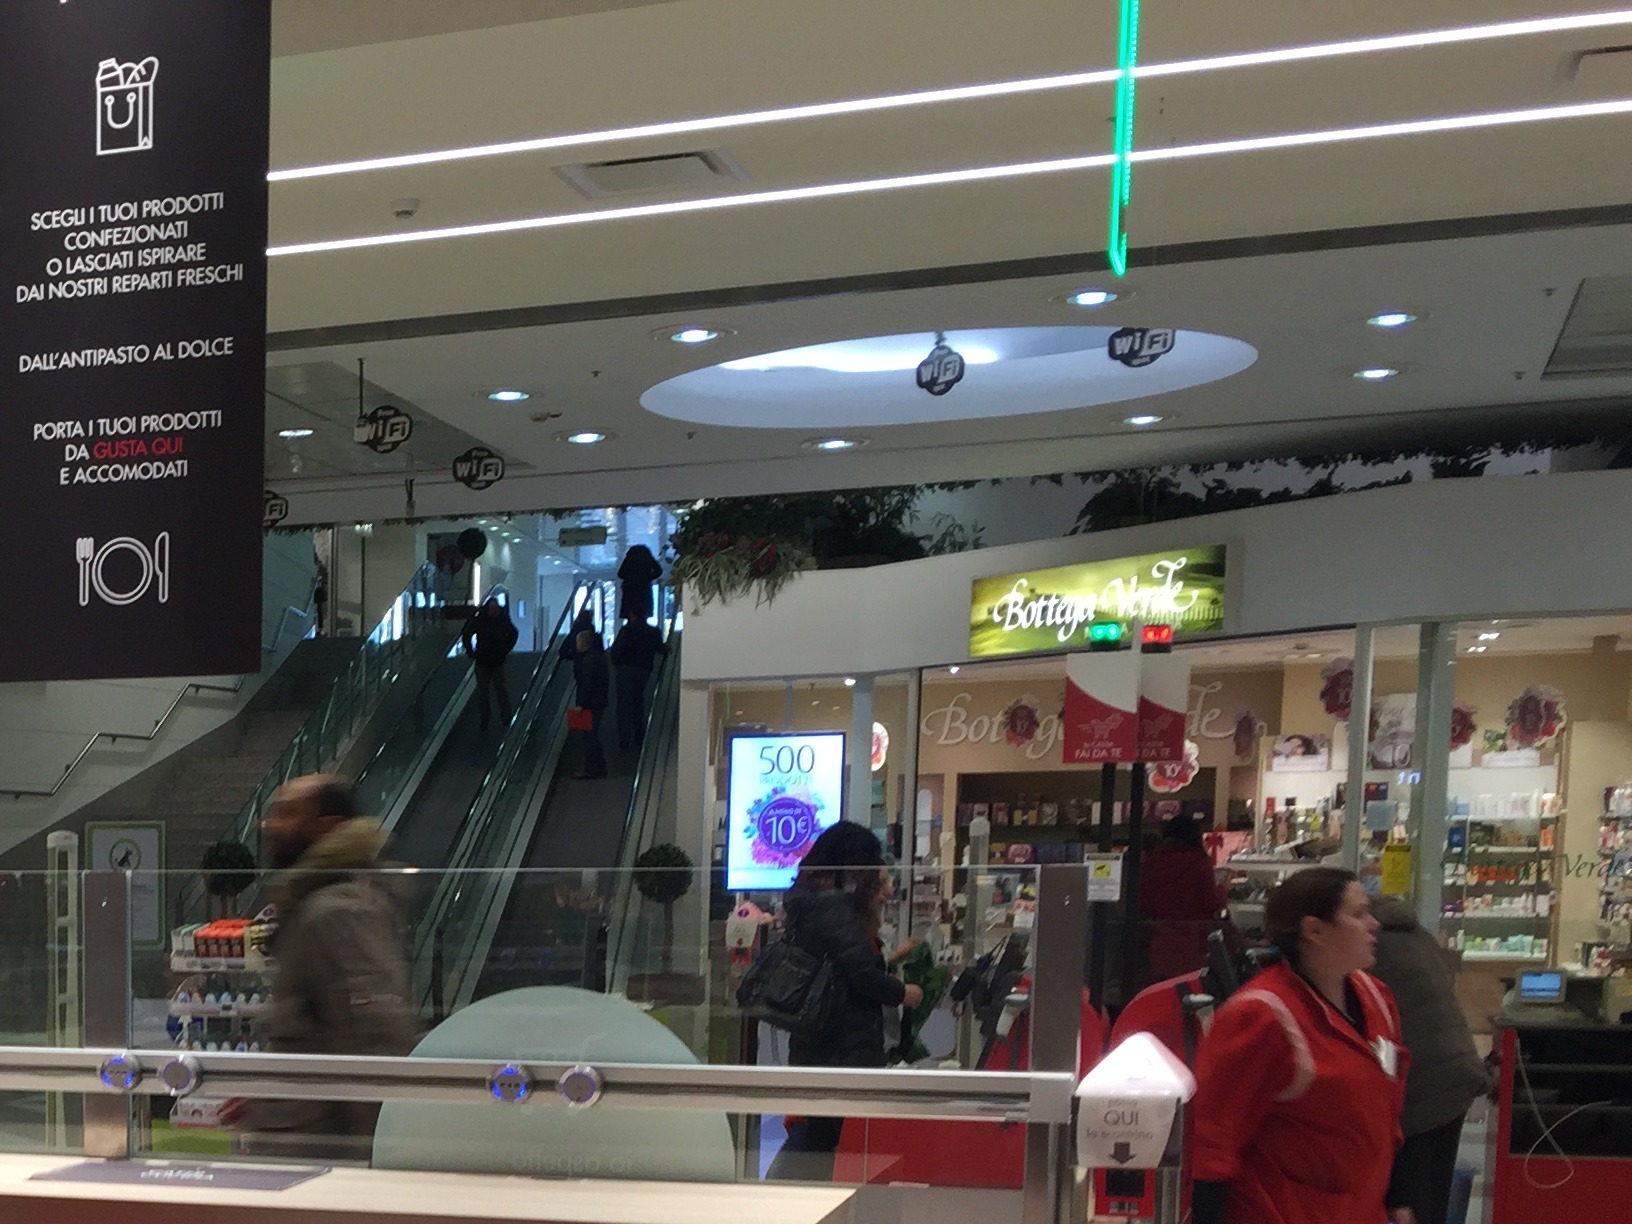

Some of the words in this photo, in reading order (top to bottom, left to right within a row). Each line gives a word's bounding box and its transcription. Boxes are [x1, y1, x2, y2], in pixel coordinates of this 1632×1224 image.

[30, 207, 85, 231] SCEGLI
[89, 206, 94, 225] I
[98, 201, 137, 224] TUOI
[142, 191, 224, 219] PRODOTTI
[64, 220, 188, 251] CONFEZIONATI
[46, 257, 62, 277] O
[65, 250, 133, 275] LASCIATI
[137, 243, 206, 267] ISPIRARE
[16, 285, 44, 303] DAI
[48, 277, 107, 300] NOSTRI
[112, 270, 172, 294] REPARTI
[177, 263, 243, 287] FRESCHI
[19, 344, 150, 372] DALL'ANTIPASTO
[153, 343, 174, 362] AL
[178, 336, 234, 359] DOLCE
[33, 421, 85, 441] PORTA
[88, 419, 93, 437] I
[97, 415, 136, 437] TUOI
[141, 410, 221, 434] PRODOTTI
[65, 444, 89, 462] DA
[93, 438, 147, 460] GUSTA
[151, 436, 183, 457] QUI
[59, 467, 69, 486] E
[73, 459, 188, 485] ACCOMODATI
[992, 578, 1097, 642] Bottega
[1099, 556, 1200, 618] Verde
[759, 744, 816, 776] 500
[765, 815, 809, 846] 10€
[1103, 1109, 1139, 1127] QUI
